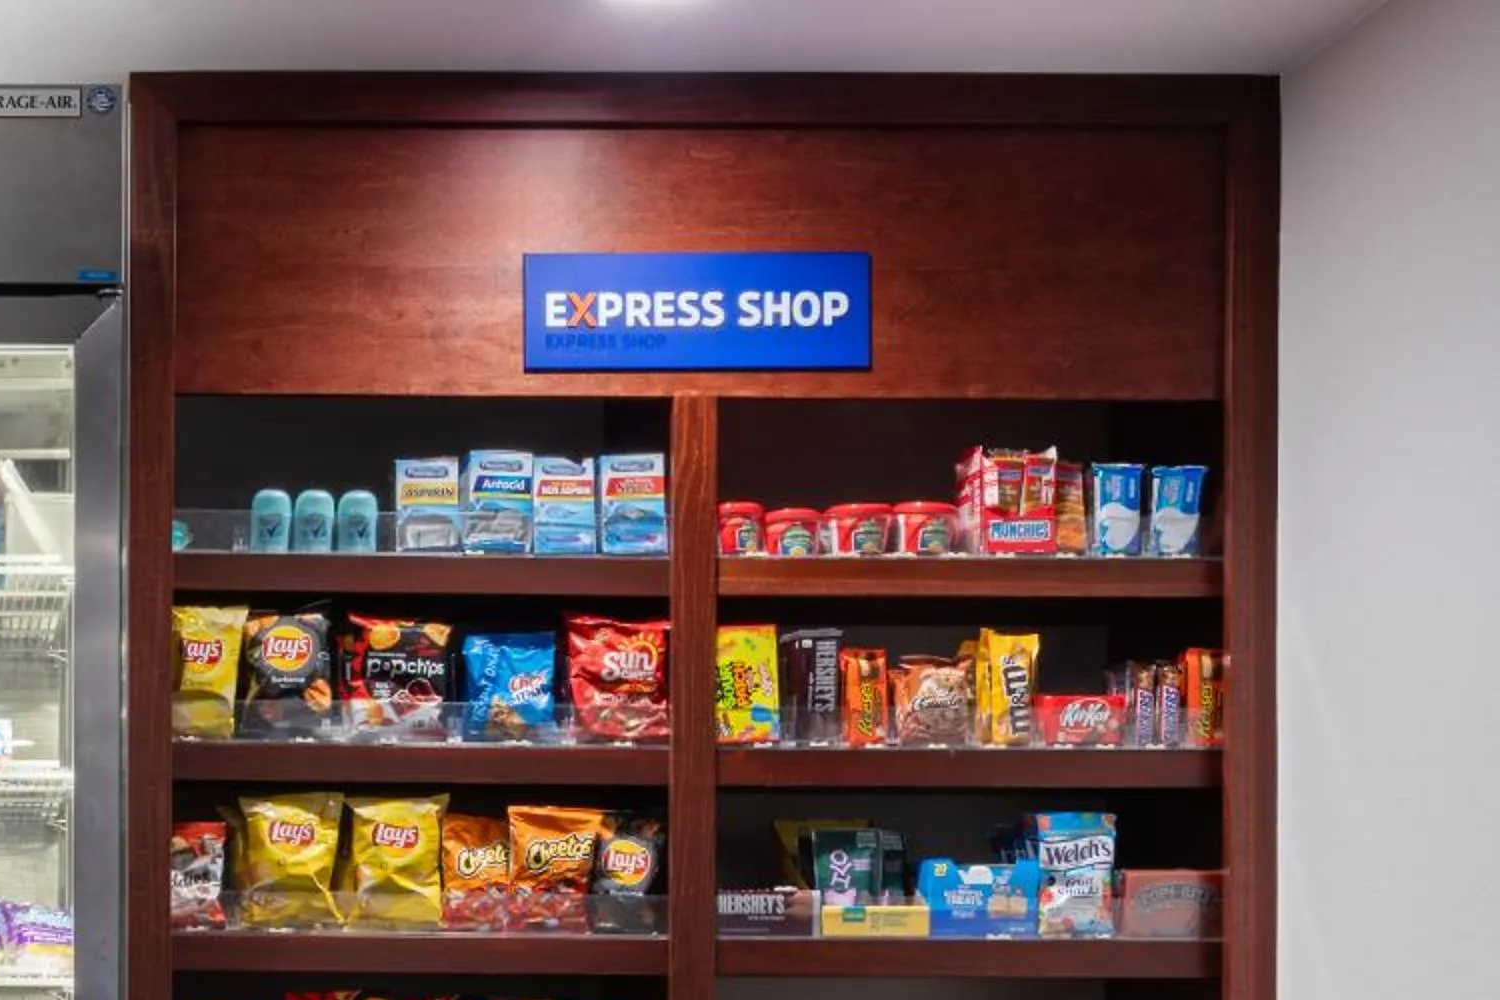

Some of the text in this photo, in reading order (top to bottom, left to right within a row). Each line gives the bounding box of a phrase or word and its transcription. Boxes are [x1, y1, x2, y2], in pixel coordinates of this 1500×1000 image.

[545, 292, 849, 328] EXPRESS SHOP
[545, 334, 667, 350] EXPRESS SHOP
[991, 521, 1049, 539] MUNCHIES
[266, 635, 310, 660] Lay's
[601, 651, 651, 681] Sun
[815, 640, 838, 712] HERSHEY'S
[271, 820, 314, 845] Lay's
[375, 823, 418, 848] Lay's
[526, 832, 594, 874] Cheetos
[609, 848, 646, 875] Lay's
[1045, 837, 1112, 866] Welch's
[719, 893, 786, 915] HERSHEY'S
